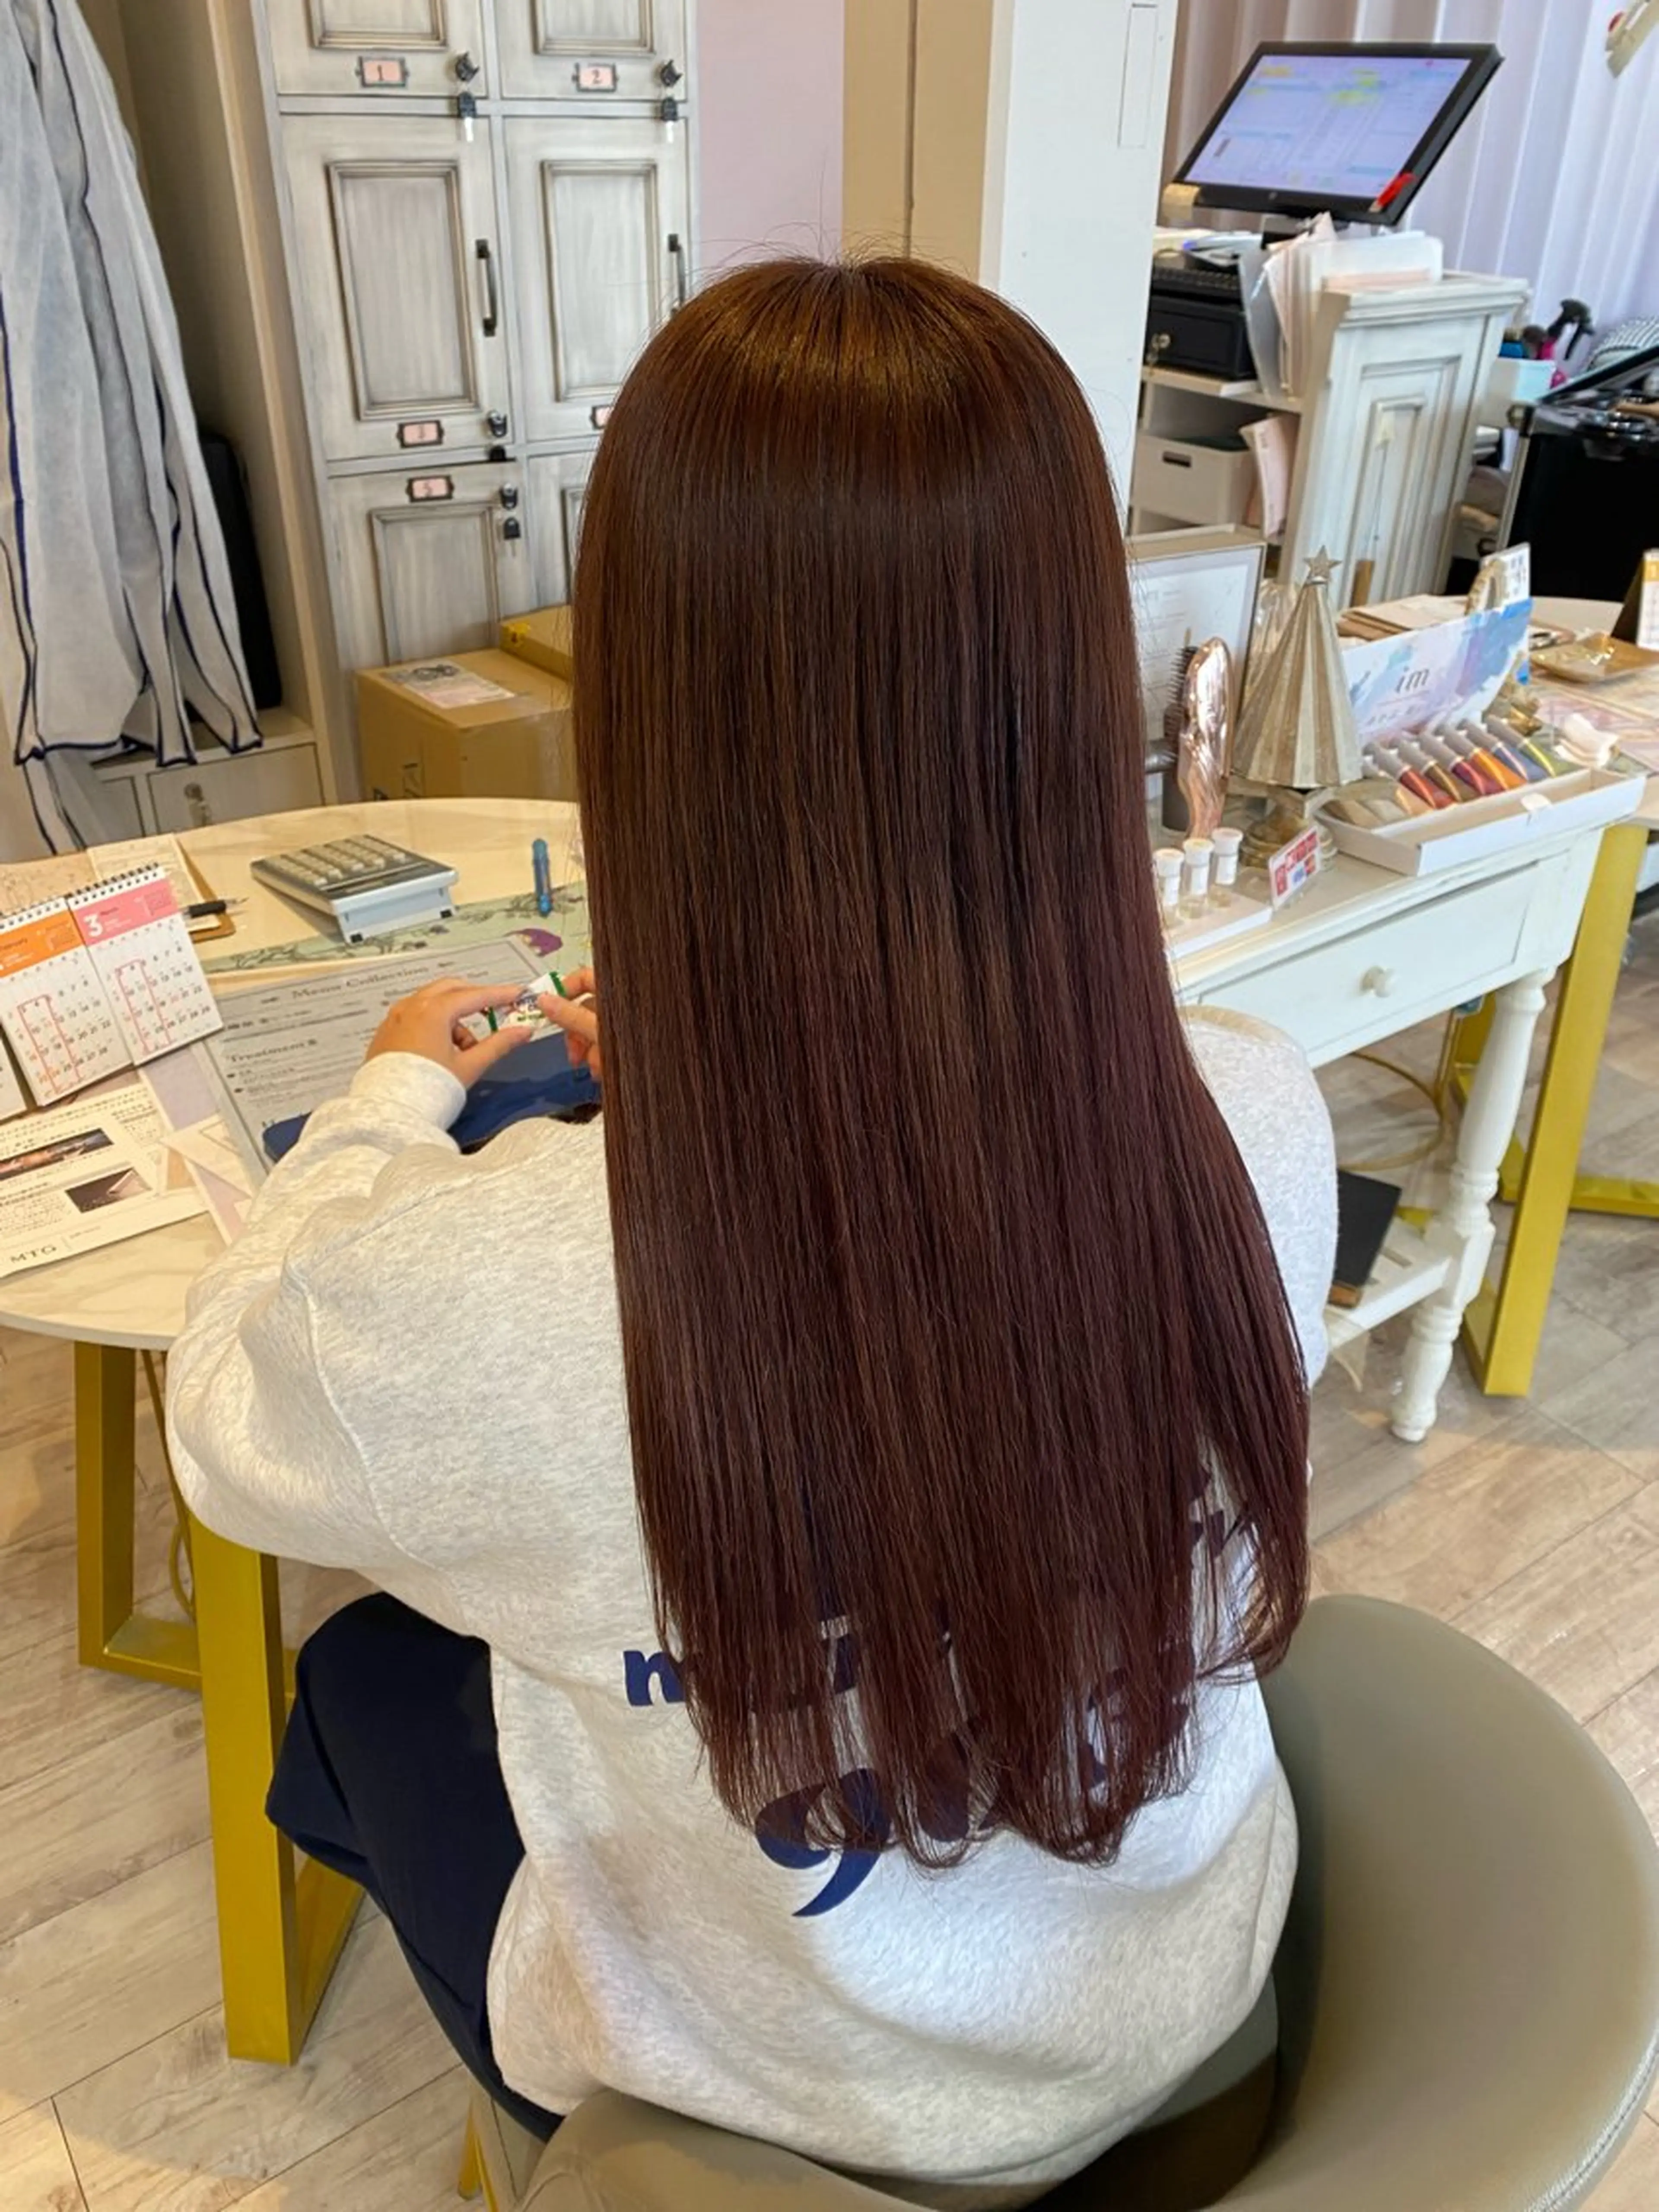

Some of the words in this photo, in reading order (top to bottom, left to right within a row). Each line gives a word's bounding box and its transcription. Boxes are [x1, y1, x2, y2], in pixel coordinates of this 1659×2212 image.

[376, 64, 385, 81] 1
[591, 69, 602, 85] 2
[1395, 666, 1430, 693] im
[84, 913, 103, 937] 3
[345, 966, 429, 988] Collection
